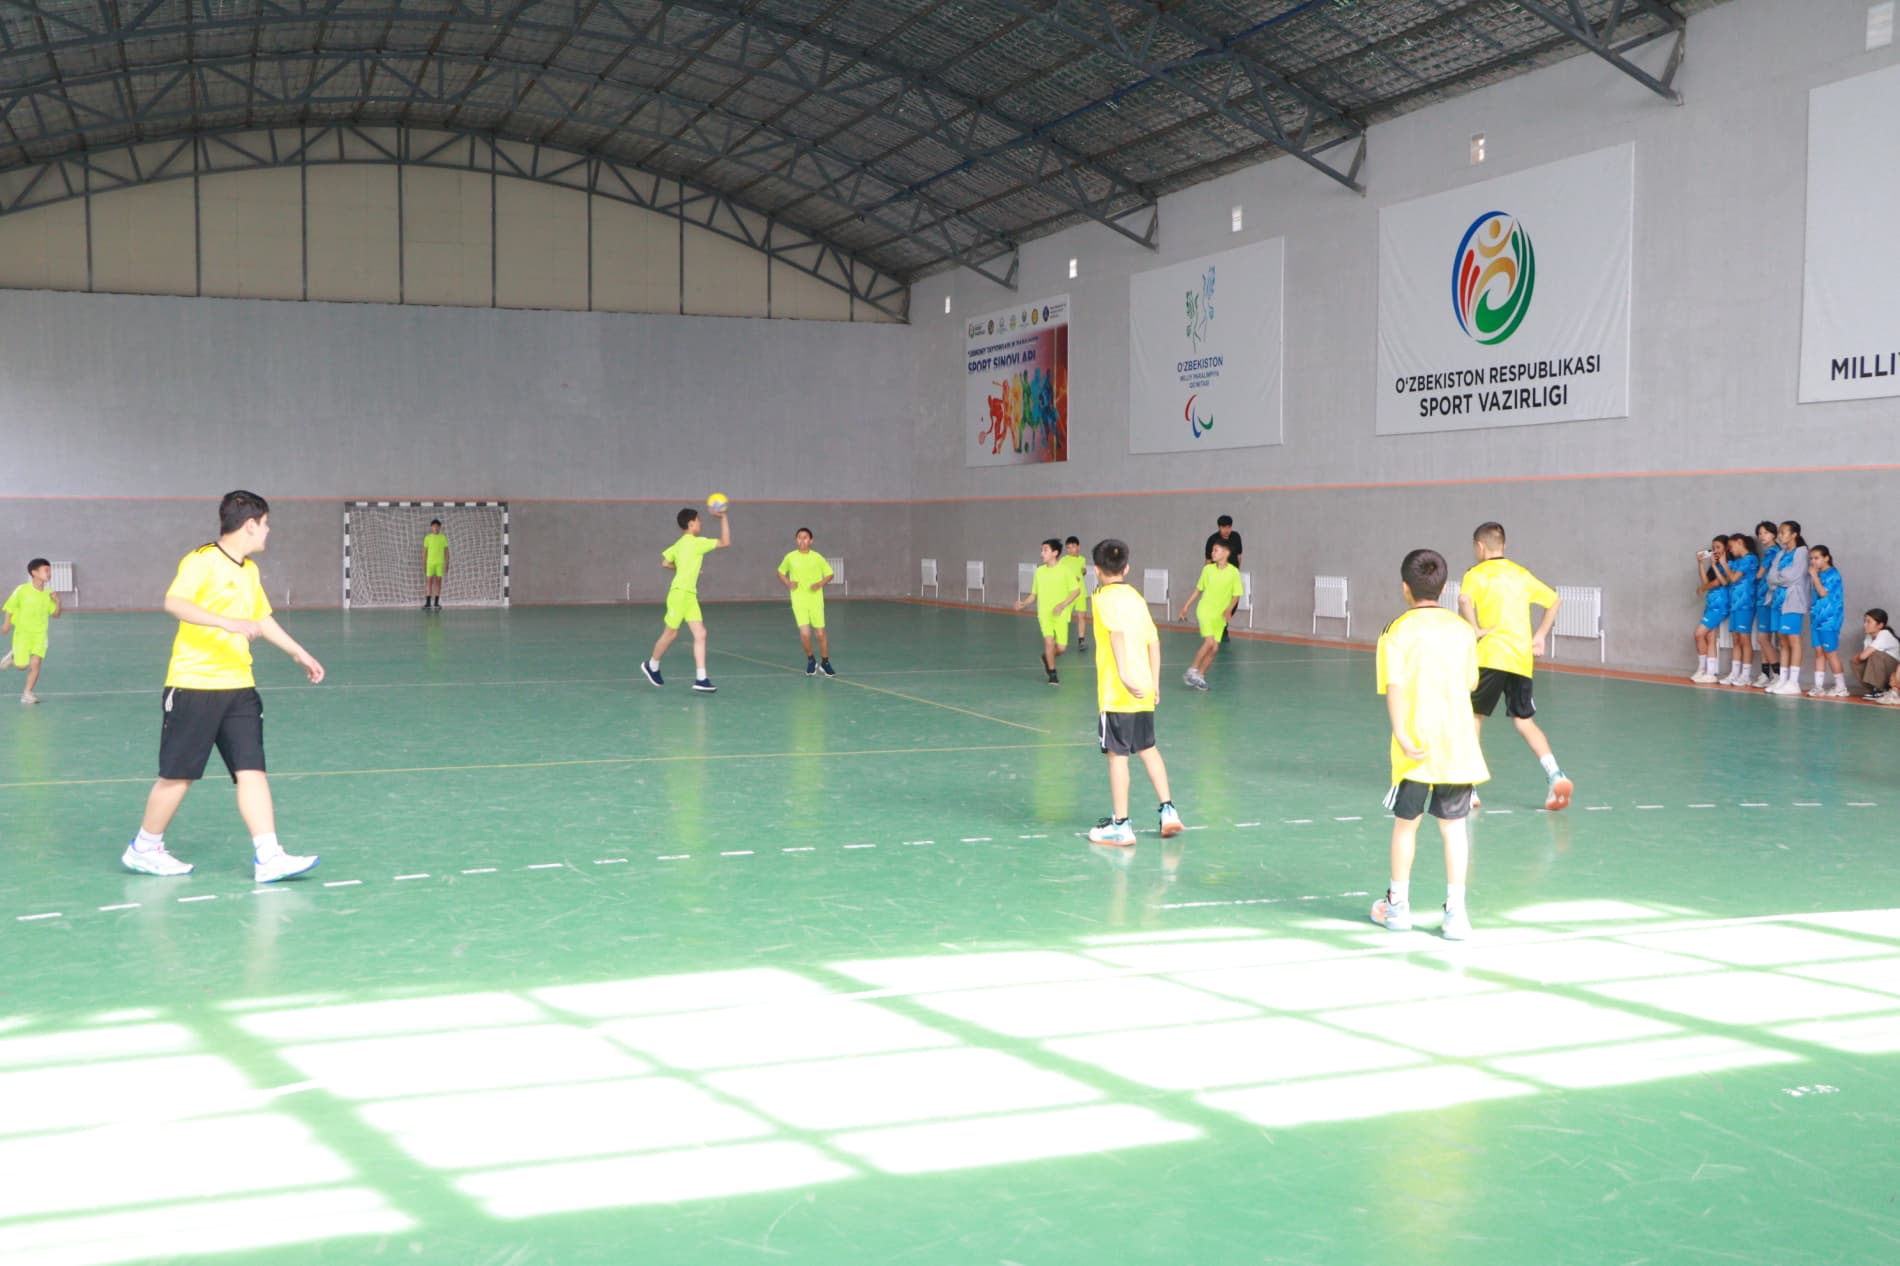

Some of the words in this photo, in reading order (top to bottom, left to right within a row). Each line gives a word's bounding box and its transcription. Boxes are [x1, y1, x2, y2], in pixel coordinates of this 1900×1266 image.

[1177, 355, 1224, 373] O'ZBEKISTON
[1395, 368, 1485, 394] O'ZBEKISTON
[1489, 354, 1601, 384] RESPUBLIKASI
[1831, 351, 1900, 381] MILLI
[1419, 394, 1473, 417] SPORT
[1478, 384, 1568, 412] VAZIRLIGI
